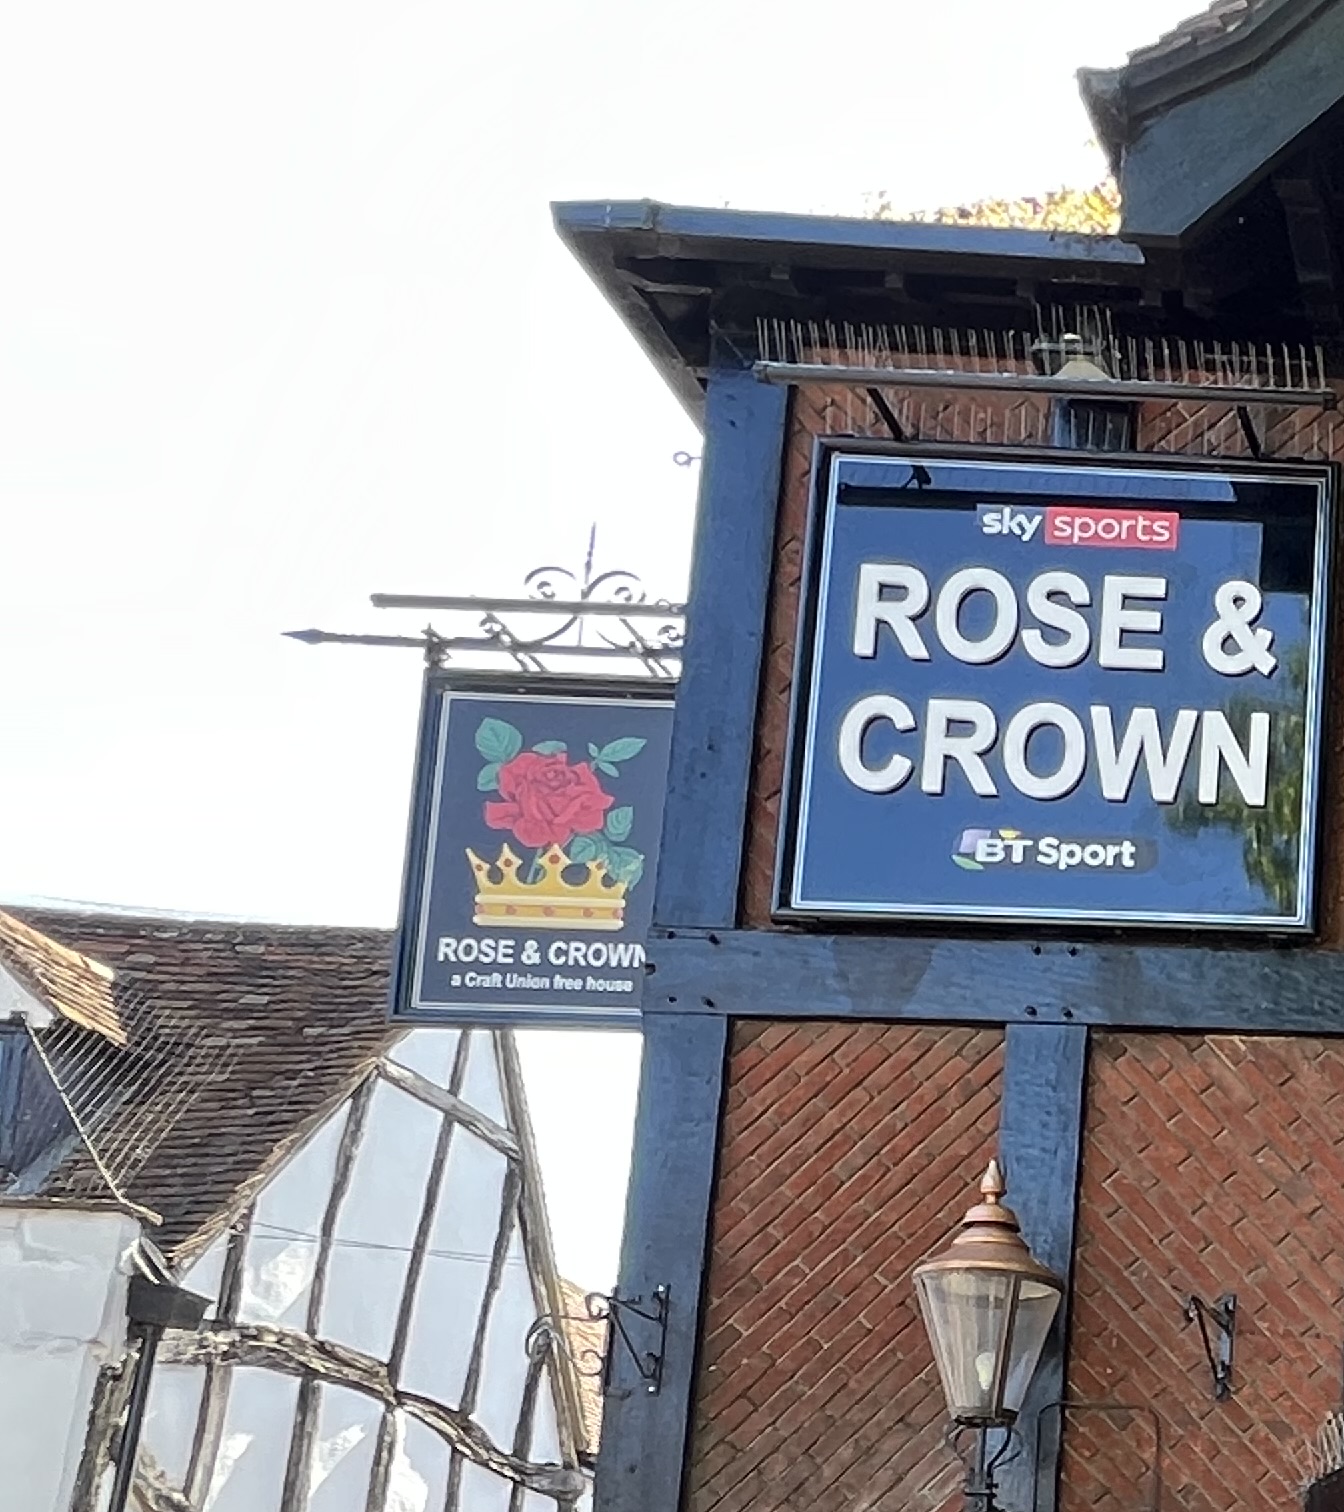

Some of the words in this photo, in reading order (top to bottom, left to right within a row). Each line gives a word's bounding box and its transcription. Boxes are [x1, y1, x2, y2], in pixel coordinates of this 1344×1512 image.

[982, 507, 1043, 541] sky
[1053, 515, 1170, 544] sports
[853, 563, 1167, 671] ROSE
[1202, 580, 1277, 677] &
[838, 694, 1270, 807] CROWN
[974, 836, 1033, 864] BT
[1036, 836, 1137, 871] Sport
[437, 937, 516, 964] ROSE
[520, 939, 541, 966] &
[548, 940, 646, 968] CROWN
[450, 973, 461, 987] a
[465, 971, 503, 988] Craft
[505, 973, 550, 990] Union
[552, 974, 583, 990] free
[586, 975, 634, 992] house
